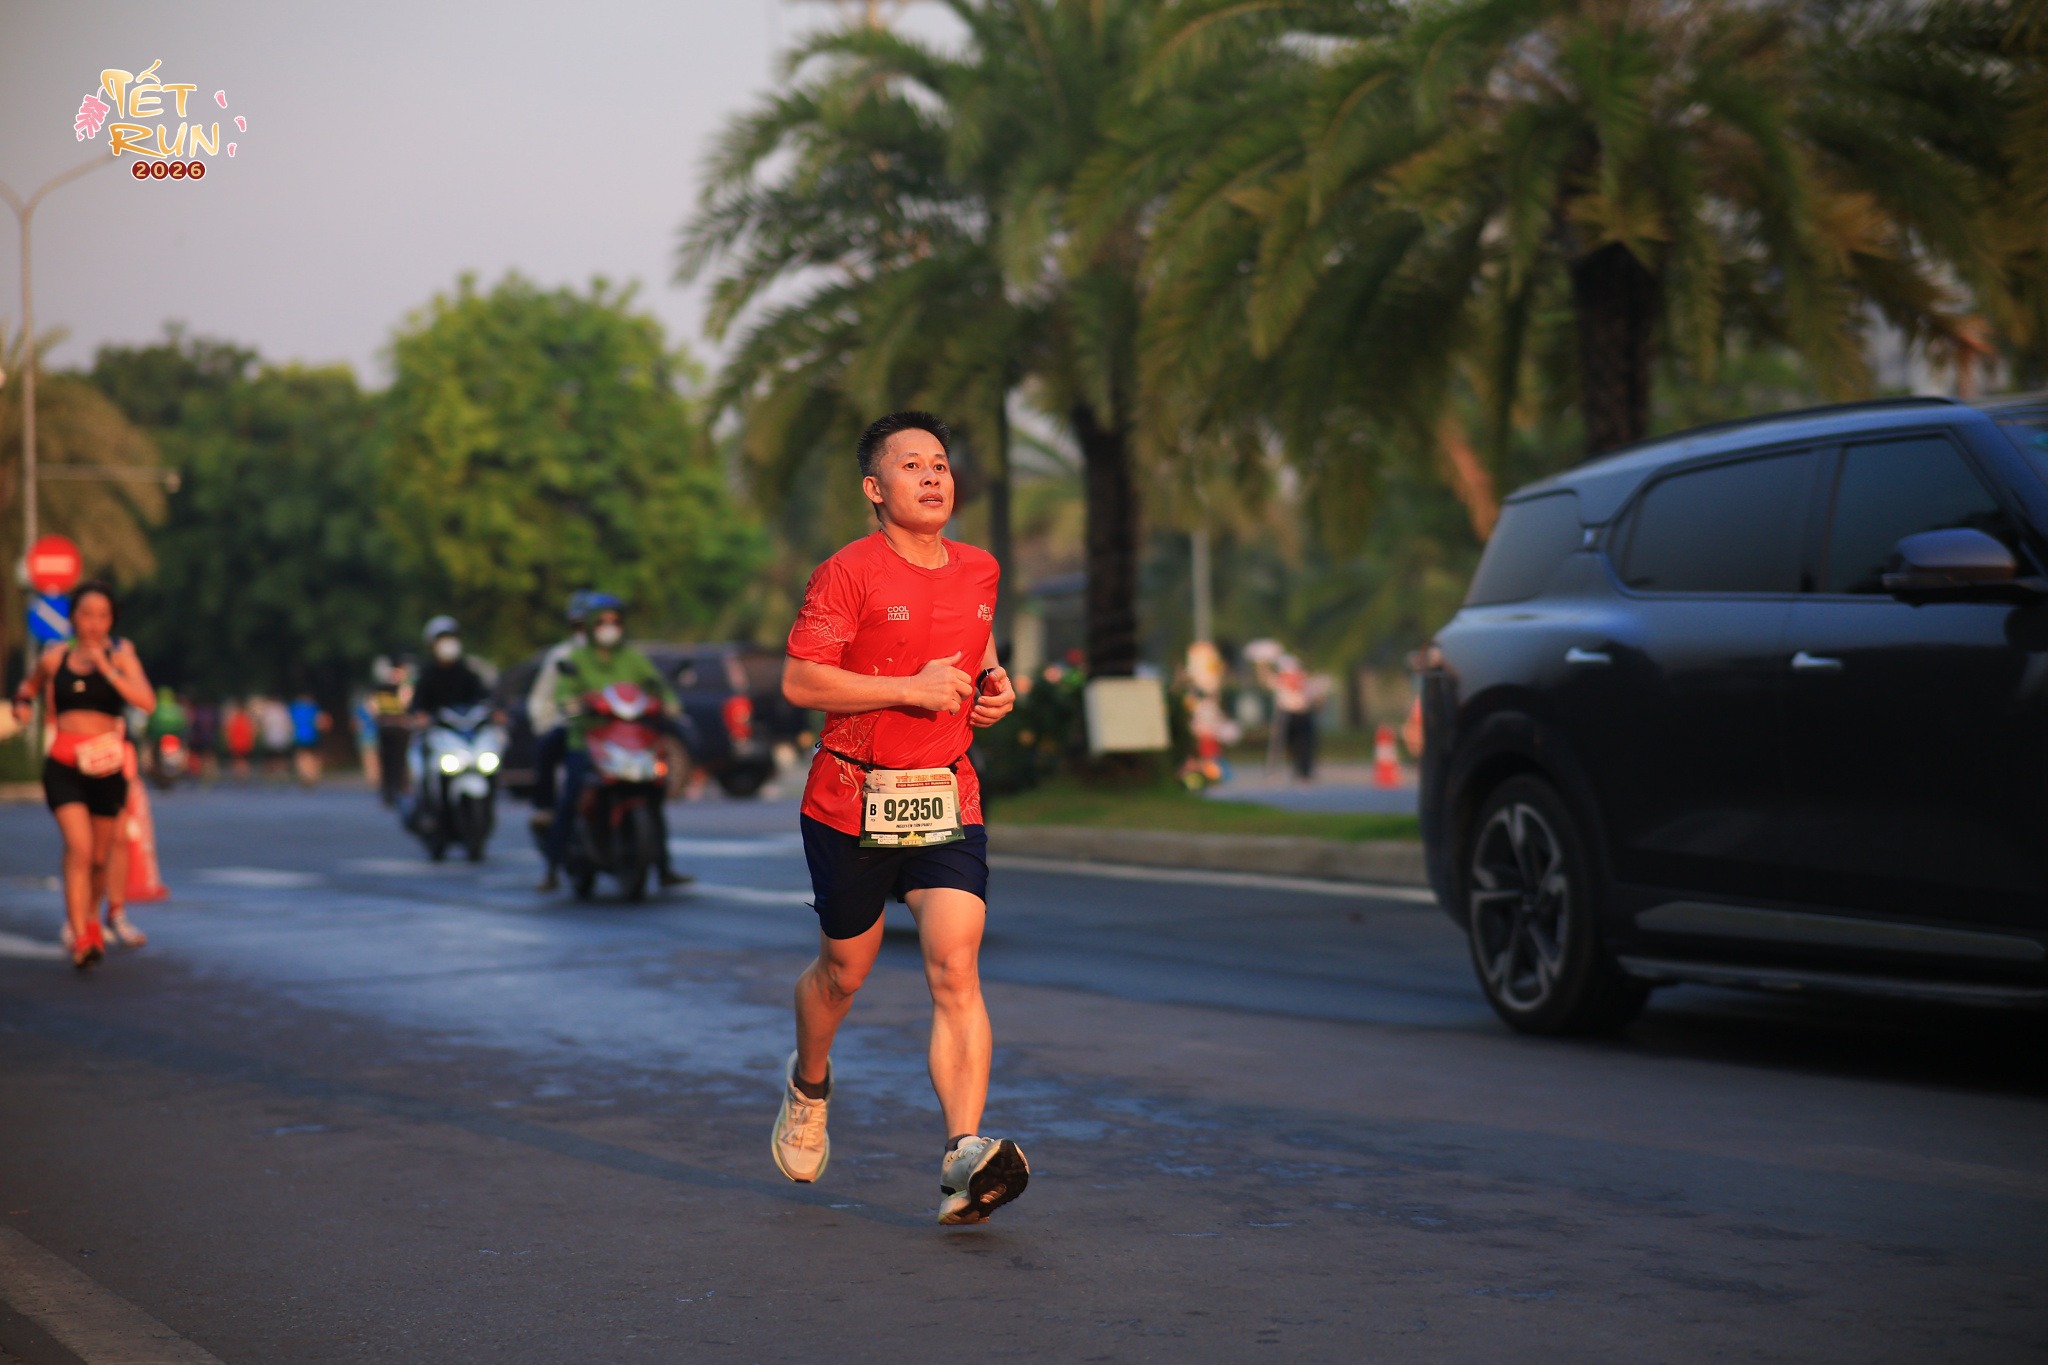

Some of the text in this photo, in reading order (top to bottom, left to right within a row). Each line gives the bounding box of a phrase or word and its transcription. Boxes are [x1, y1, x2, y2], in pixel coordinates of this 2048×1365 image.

[887, 605, 909, 613] COOL
[870, 804, 877, 815] B
[884, 797, 944, 821] 92350
